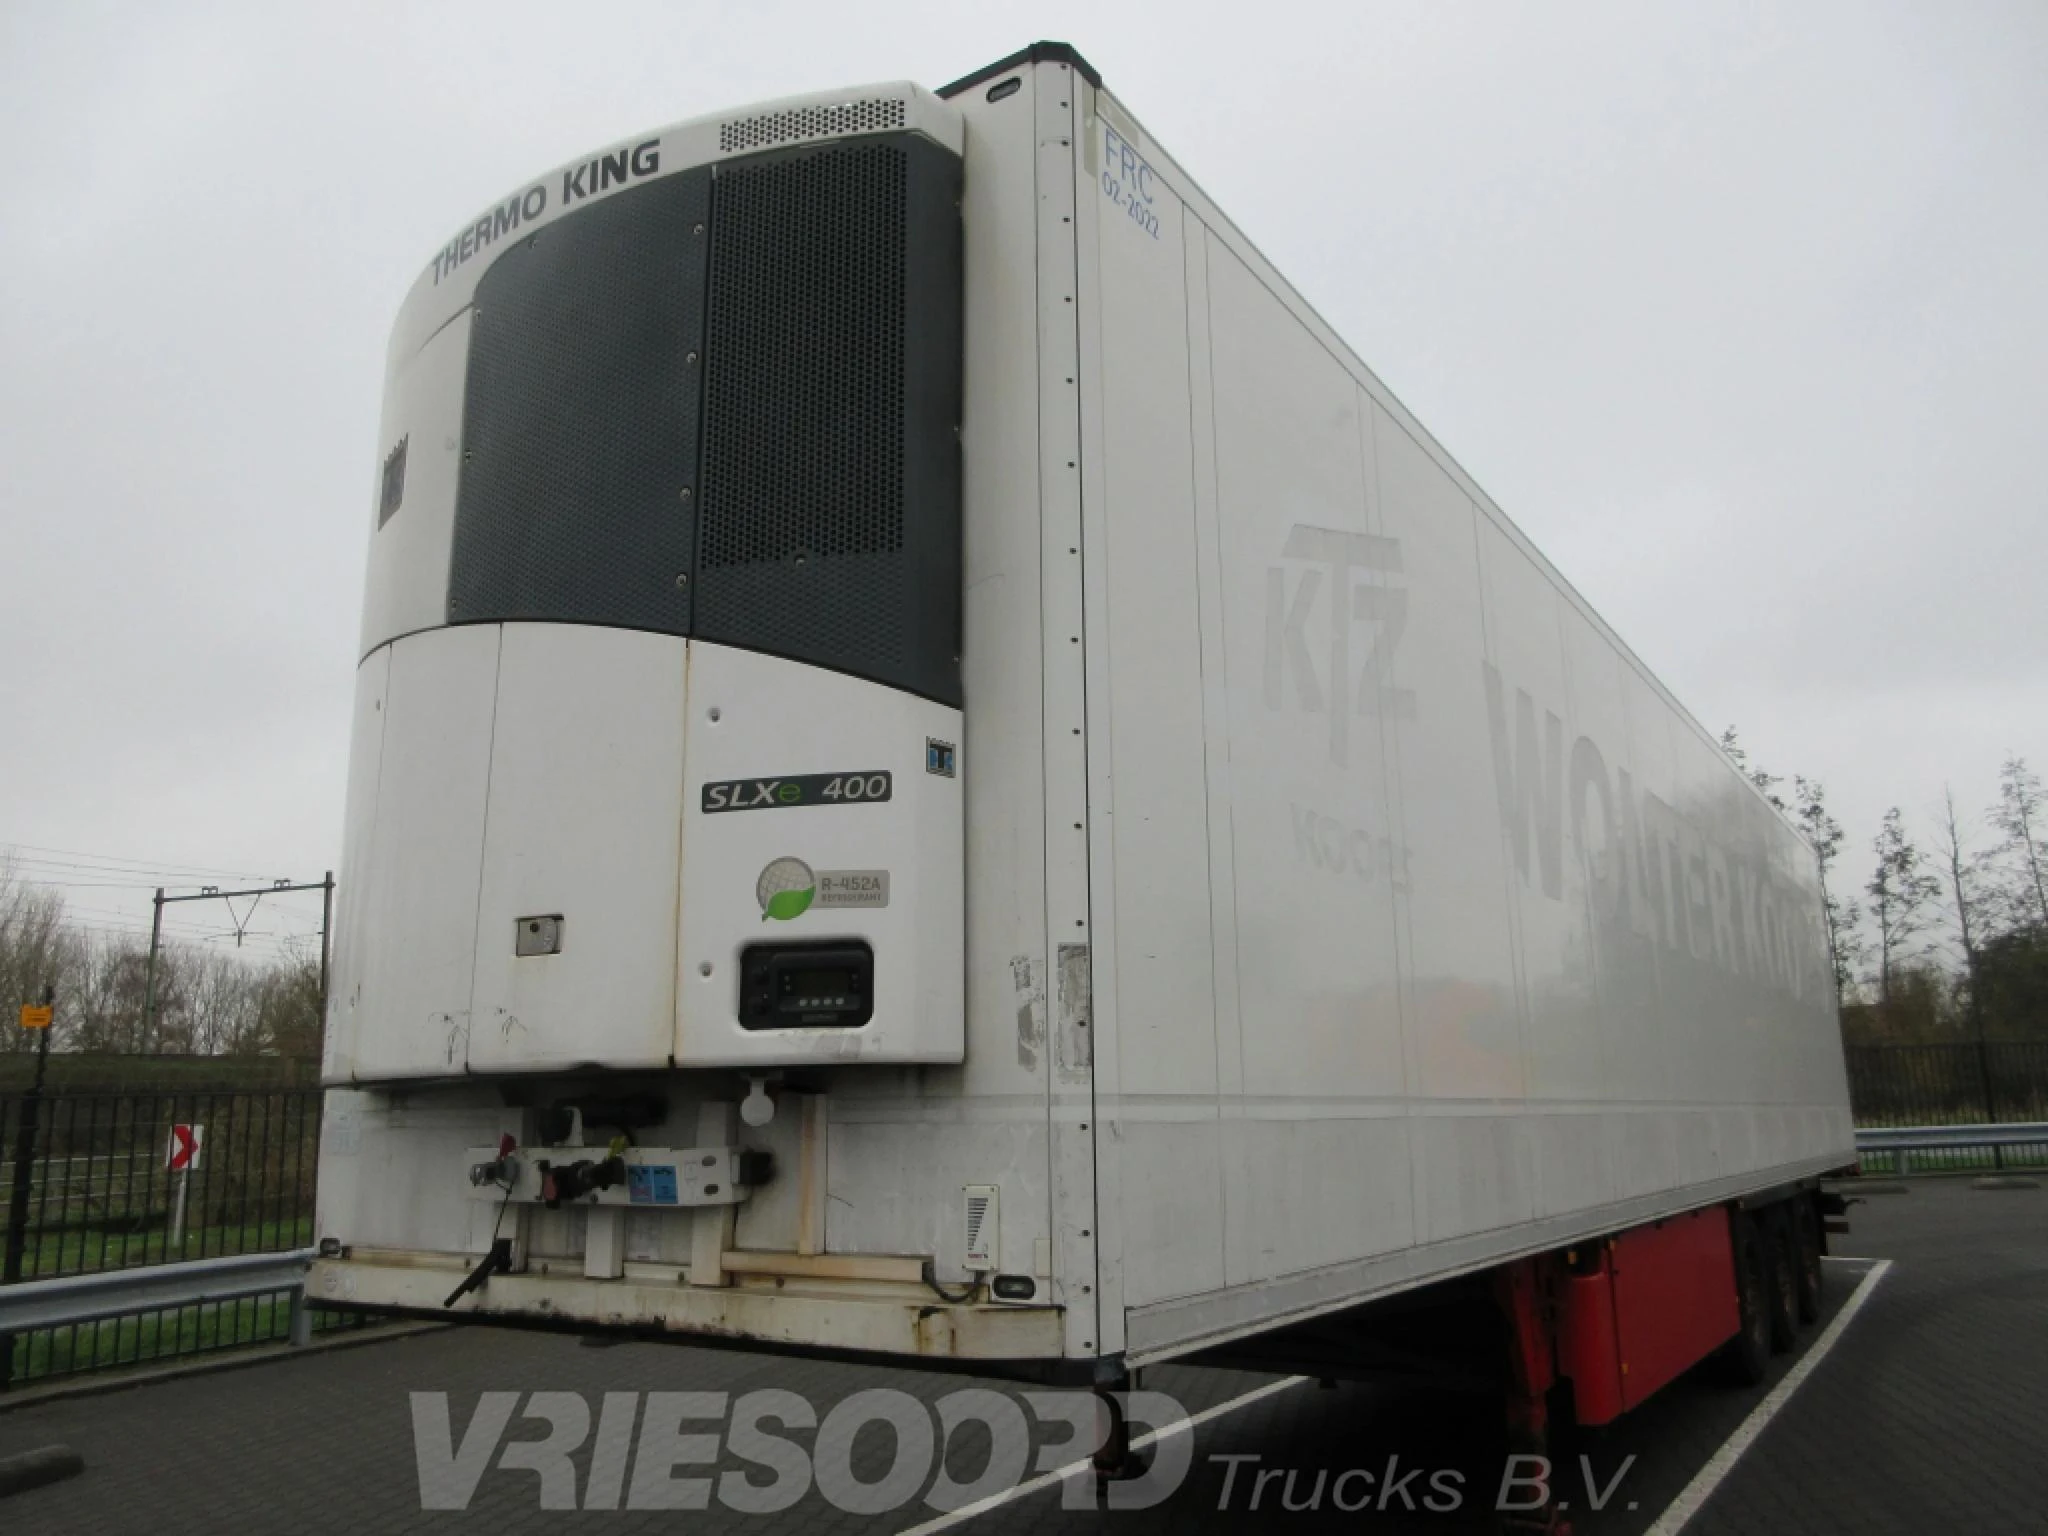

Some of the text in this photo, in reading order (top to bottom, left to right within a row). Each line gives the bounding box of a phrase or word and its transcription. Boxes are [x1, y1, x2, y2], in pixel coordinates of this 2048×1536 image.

[1106, 127, 1153, 205] FRC
[431, 138, 660, 286] THERMO KING
[1102, 171, 1160, 241] 02-2022
[705, 775, 888, 809] SLXe 400
[821, 876, 881, 891] R-452A
